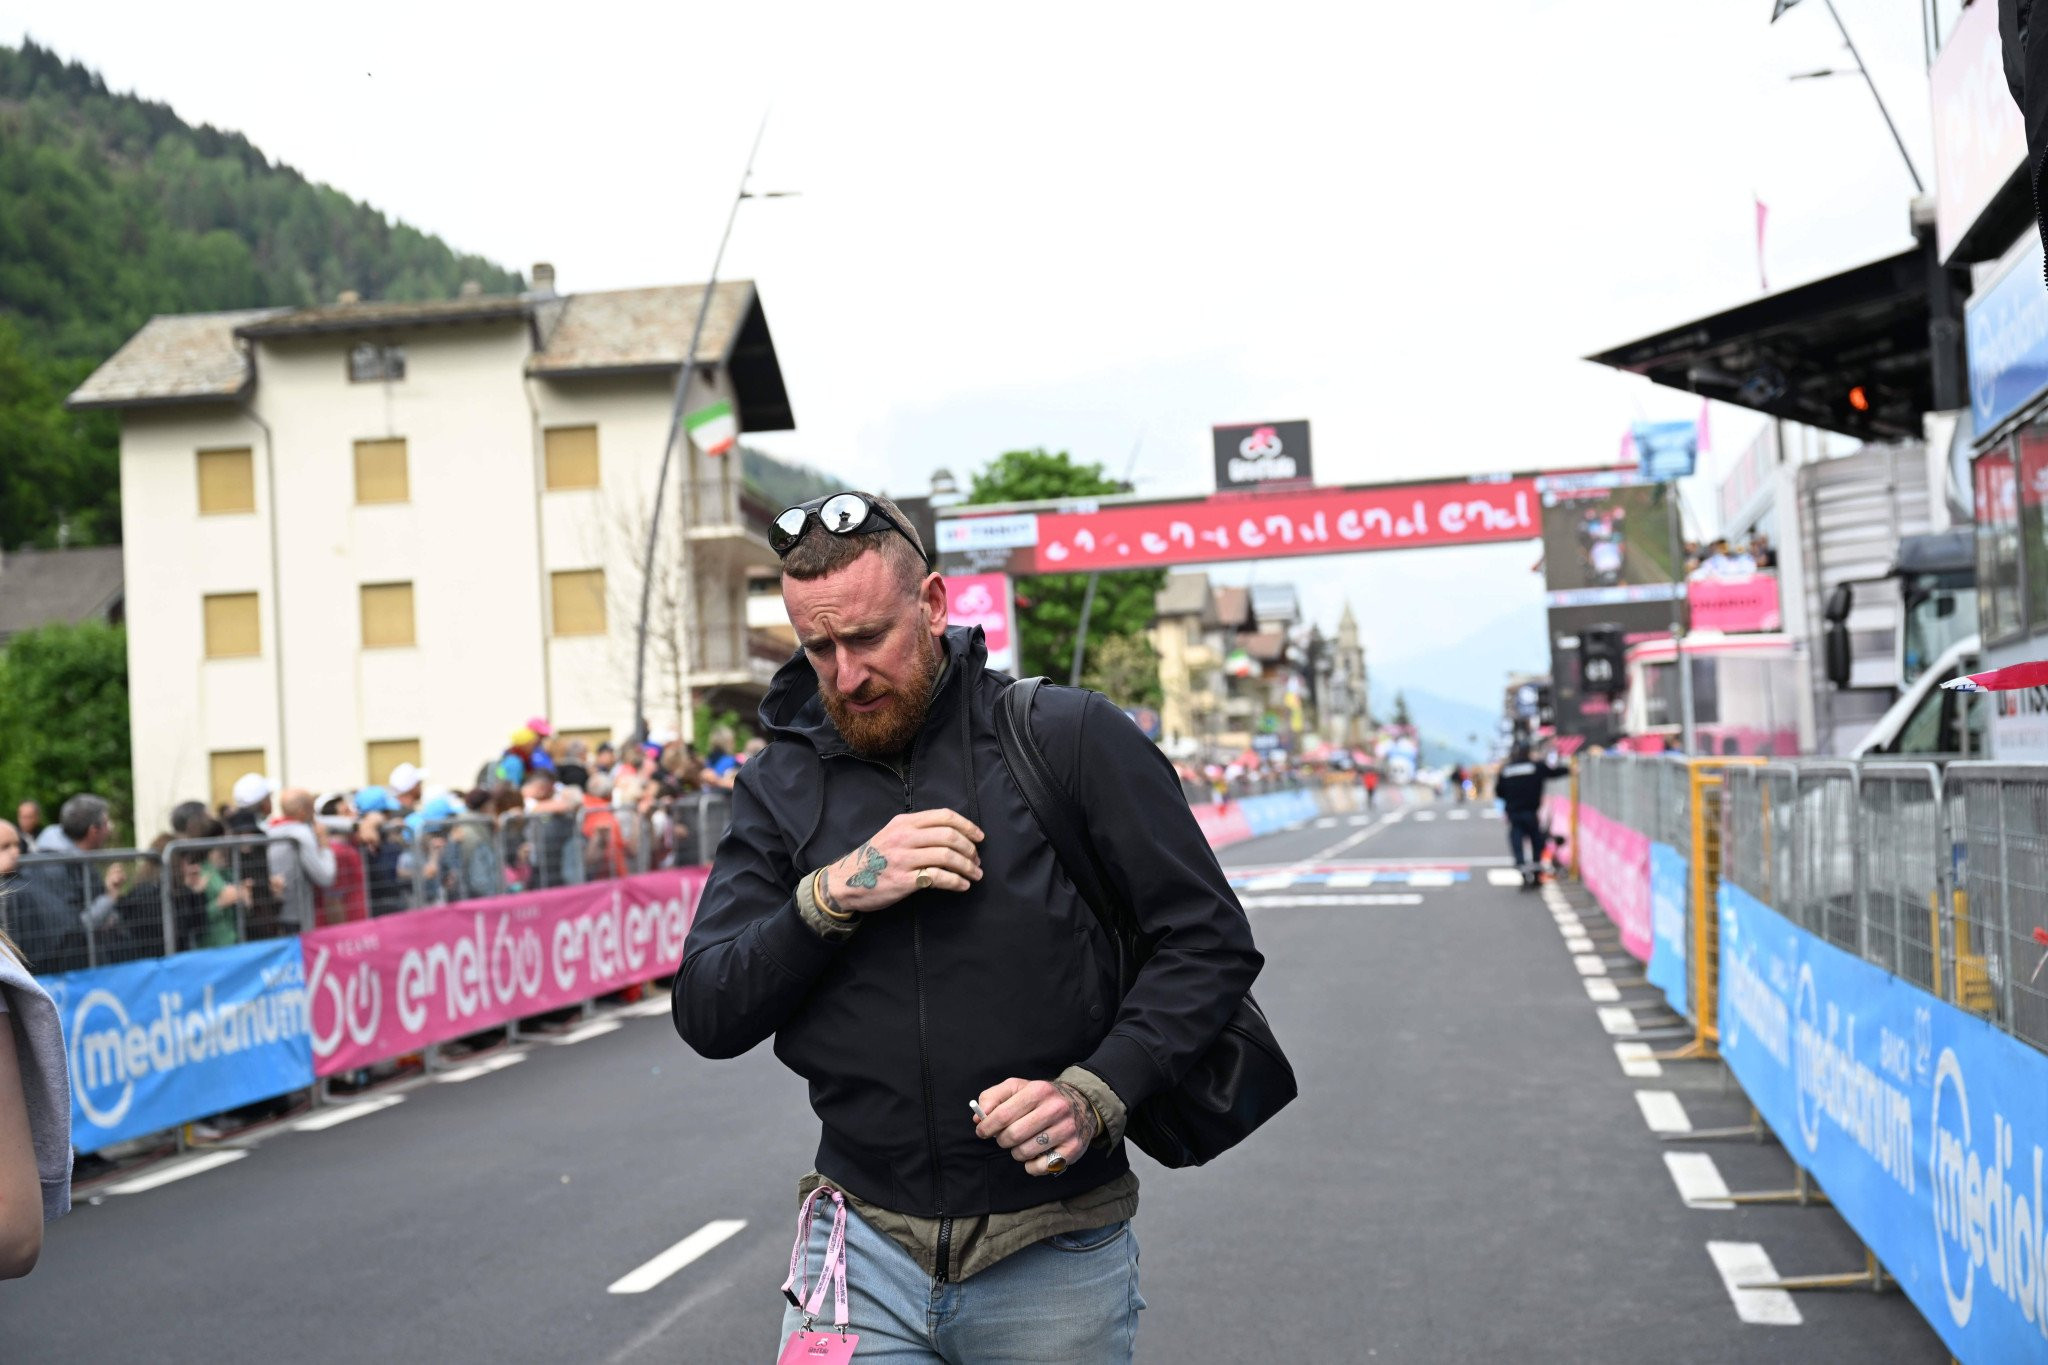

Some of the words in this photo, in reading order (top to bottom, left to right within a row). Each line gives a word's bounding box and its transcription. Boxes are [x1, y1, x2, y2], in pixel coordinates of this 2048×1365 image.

[397, 912, 490, 1033] enel
[553, 891, 624, 990] enel
[624, 879, 691, 970] enel
[82, 985, 310, 1090] mediolanum
[1938, 1112, 2048, 1341] mediol
